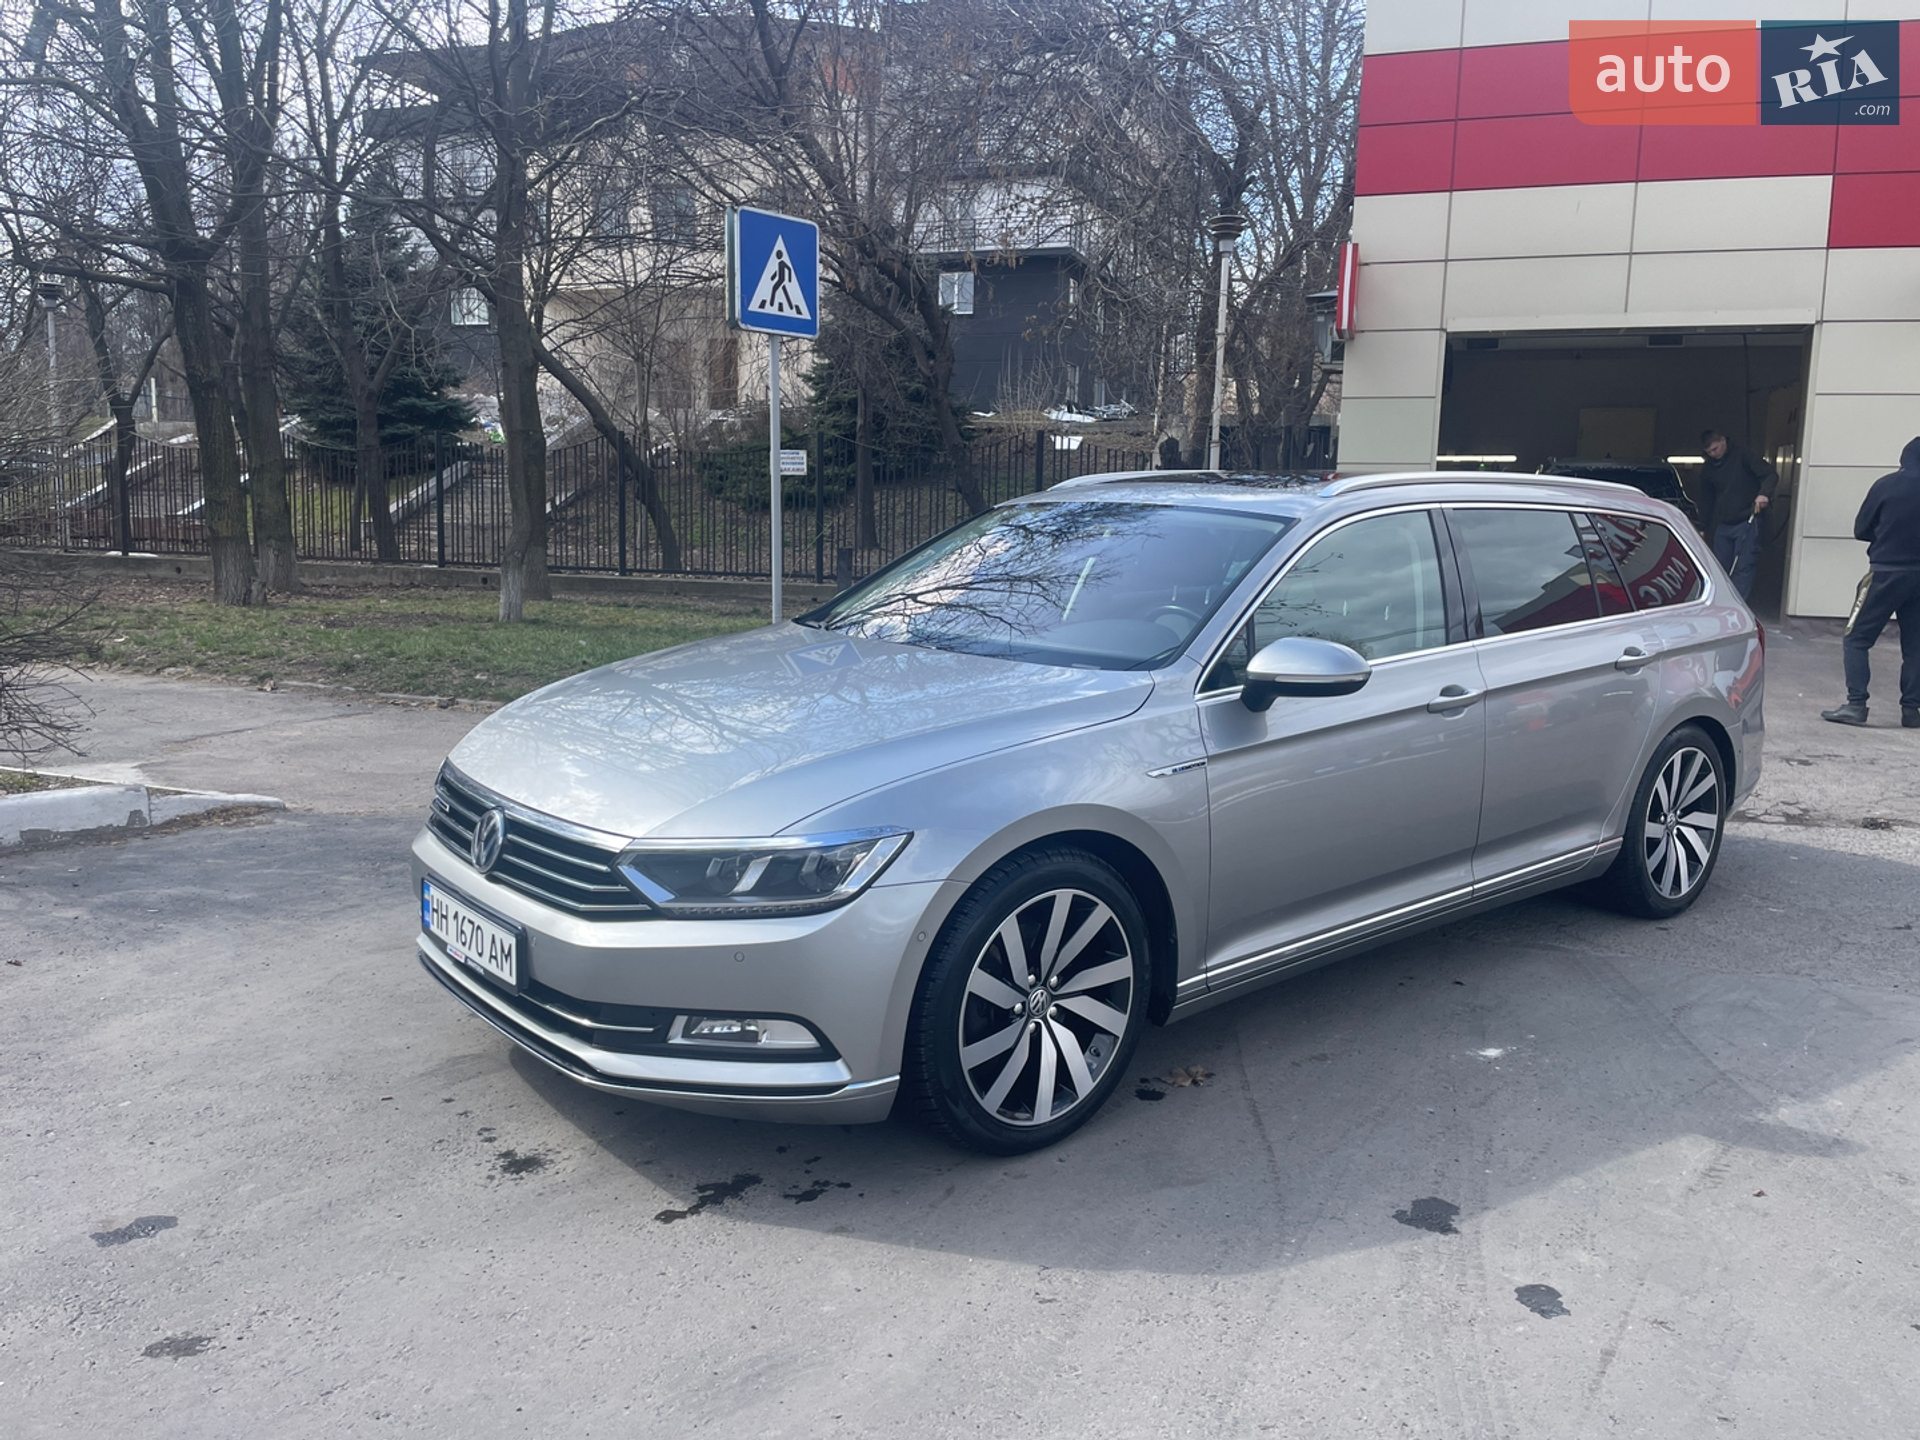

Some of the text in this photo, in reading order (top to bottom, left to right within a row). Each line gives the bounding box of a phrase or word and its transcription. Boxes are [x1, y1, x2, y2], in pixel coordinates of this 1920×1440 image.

[430, 895, 449, 936] HH
[453, 910, 484, 957] 1670
[489, 933, 513, 977] AM
